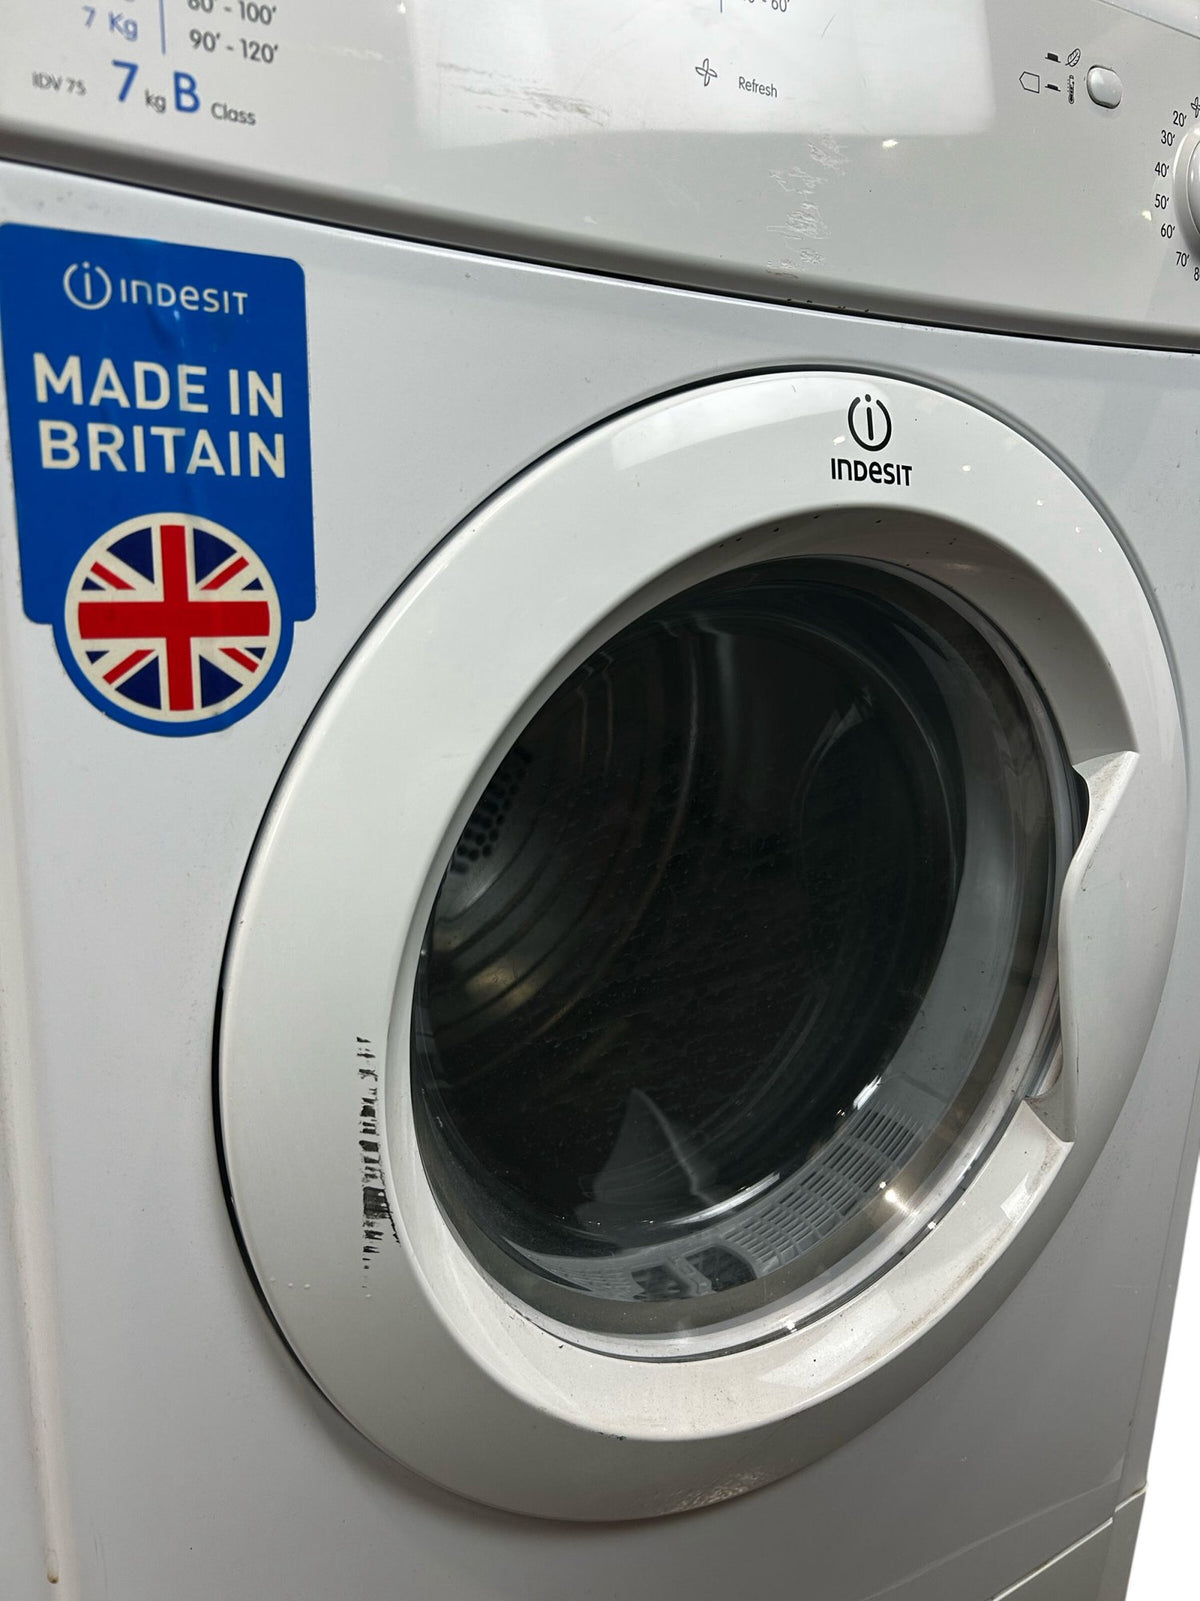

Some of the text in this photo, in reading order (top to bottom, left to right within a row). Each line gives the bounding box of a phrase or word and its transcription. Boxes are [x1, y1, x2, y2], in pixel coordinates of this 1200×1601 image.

[82, 5, 138, 42] 7 Kg
[189, 29, 221, 52] 90'
[239, 38, 279, 64] 120'
[111, 59, 138, 102] 7
[145, 89, 166, 113] kg
[173, 71, 200, 113] B
[210, 102, 256, 126] Class
[738, 76, 778, 98] Refresh
[1172, 110, 1187, 127] 20'
[1160, 130, 1175, 146] 30'
[1154, 162, 1169, 177] 40'
[1154, 195, 1169, 210] 50'
[1160, 225, 1175, 239] 60'
[1176, 250, 1190, 267] 70'
[33, 352, 284, 418] MADE IN
[38, 419, 286, 479] BRITAIN
